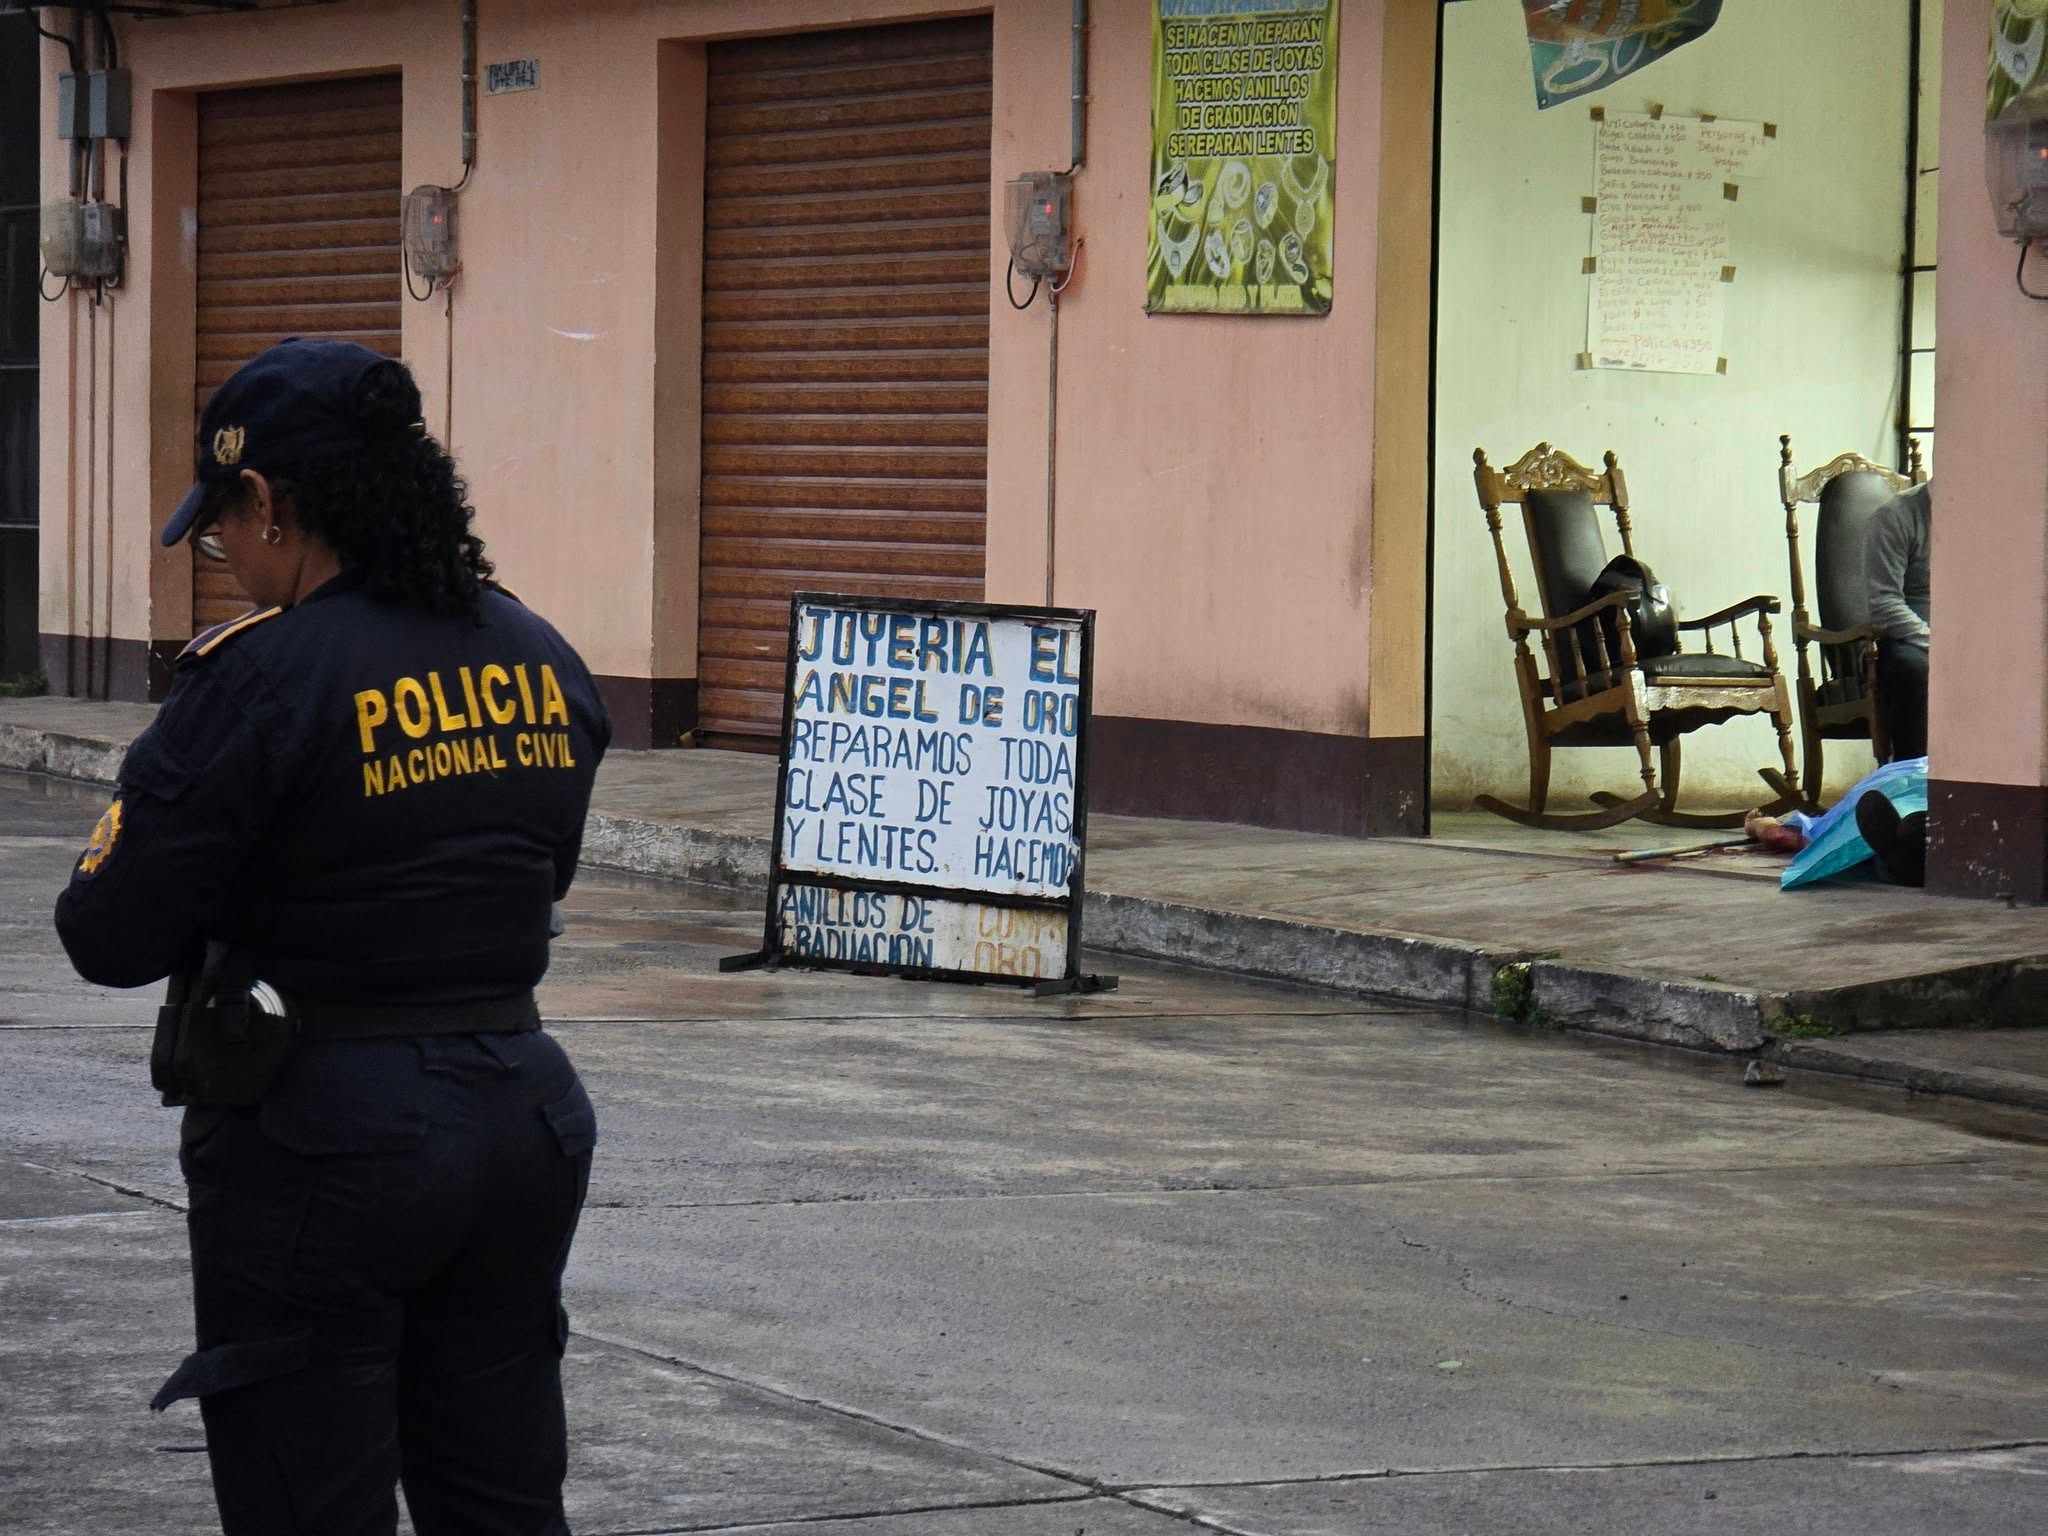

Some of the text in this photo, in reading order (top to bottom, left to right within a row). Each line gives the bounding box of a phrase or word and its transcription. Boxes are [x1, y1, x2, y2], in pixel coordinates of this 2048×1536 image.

[1167, 18, 1324, 49] SE HACEN Y REPARAN
[1166, 45, 1325, 76] TODA CLASE DE JOYAS
[1174, 74, 1310, 103] HACEMOS ANILLOS
[1181, 99, 1299, 130] DE GRADUACIÓN
[1169, 129, 1314, 157] SE REPARAN LENTES
[800, 608, 1079, 685] JOYERIA EL
[354, 663, 570, 753] POLICIA
[796, 669, 1078, 737] ANGEL DE ORO
[363, 733, 576, 797] NACIONAL CIVIL
[789, 718, 1073, 790] REPARAMOS TODA
[786, 768, 1071, 834] CLASE DE JOYAS
[787, 816, 805, 858] Y
[817, 819, 939, 873] LENTES.
[780, 884, 935, 933] ANILLOS DE
[975, 942, 1041, 977] ORO
